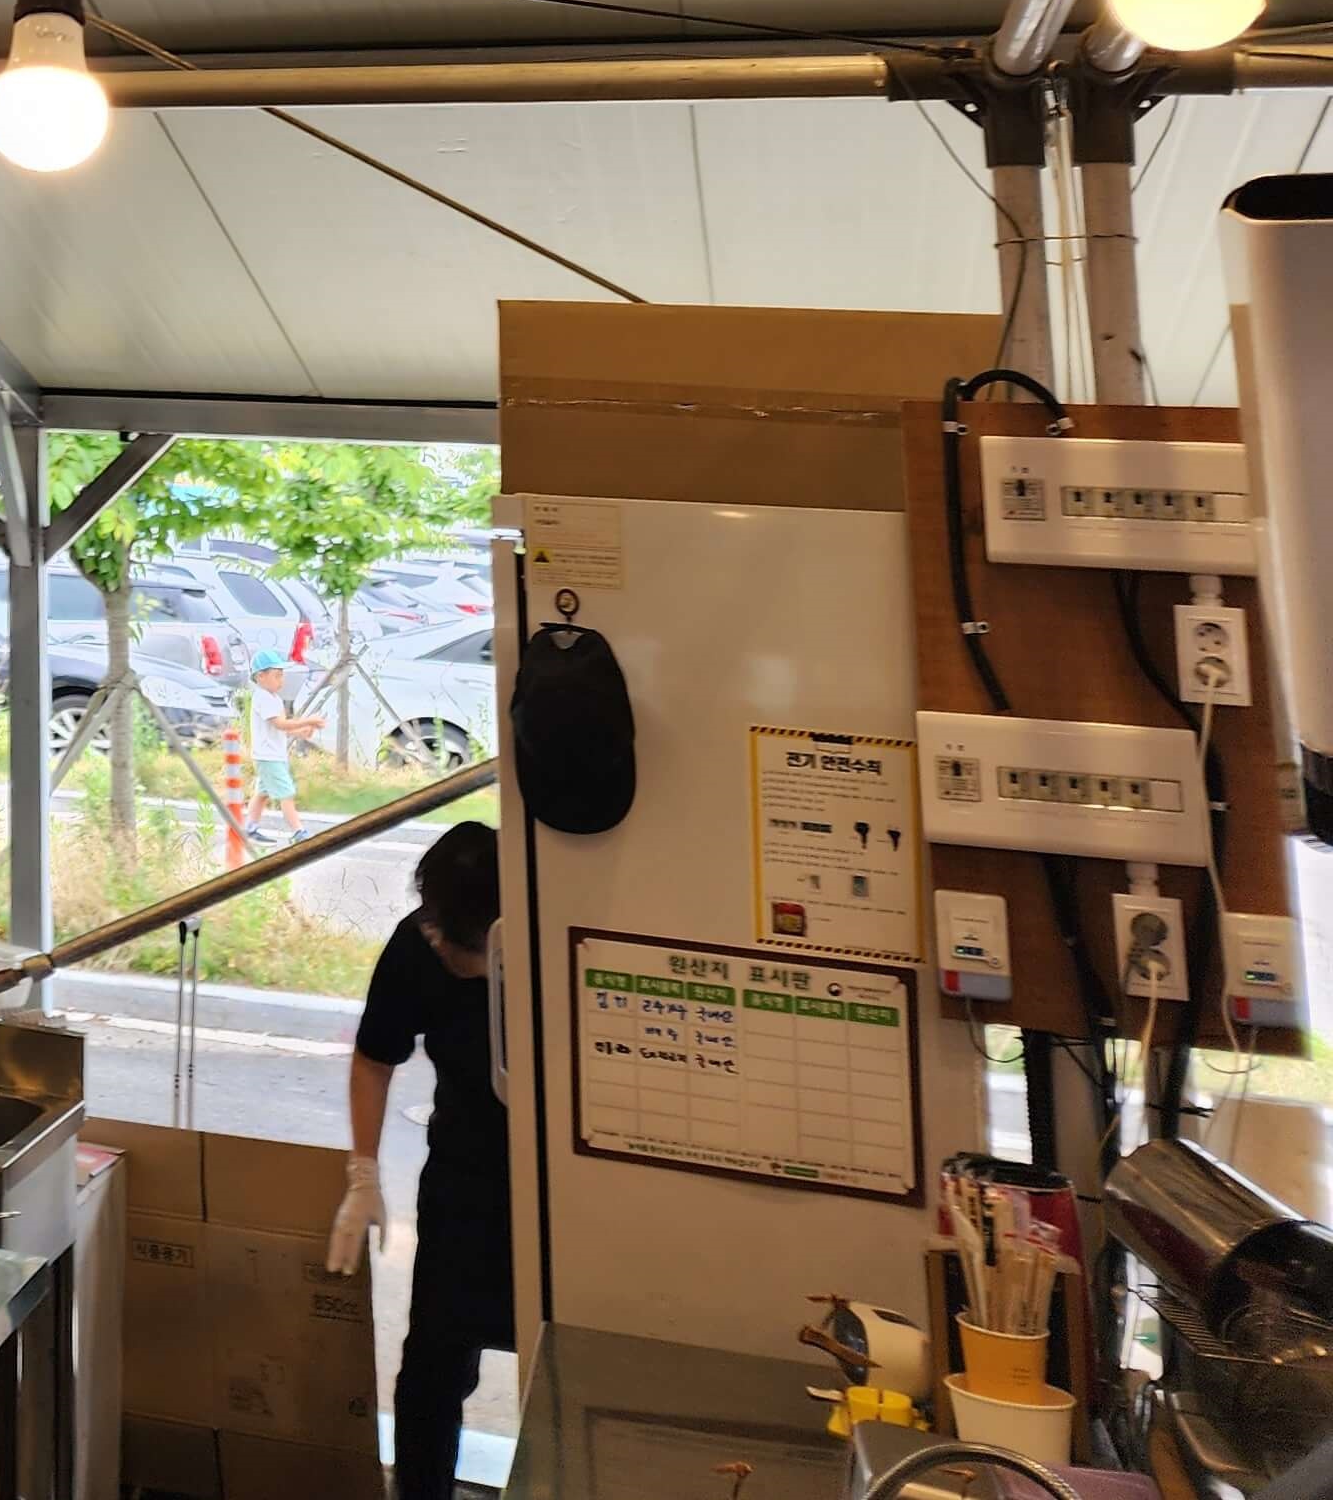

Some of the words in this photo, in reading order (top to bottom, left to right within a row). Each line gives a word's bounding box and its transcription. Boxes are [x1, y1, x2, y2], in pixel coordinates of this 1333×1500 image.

[786, 751, 816, 769] 전기
[668, 955, 729, 980] 원산지
[749, 966, 811, 991] 표시판
